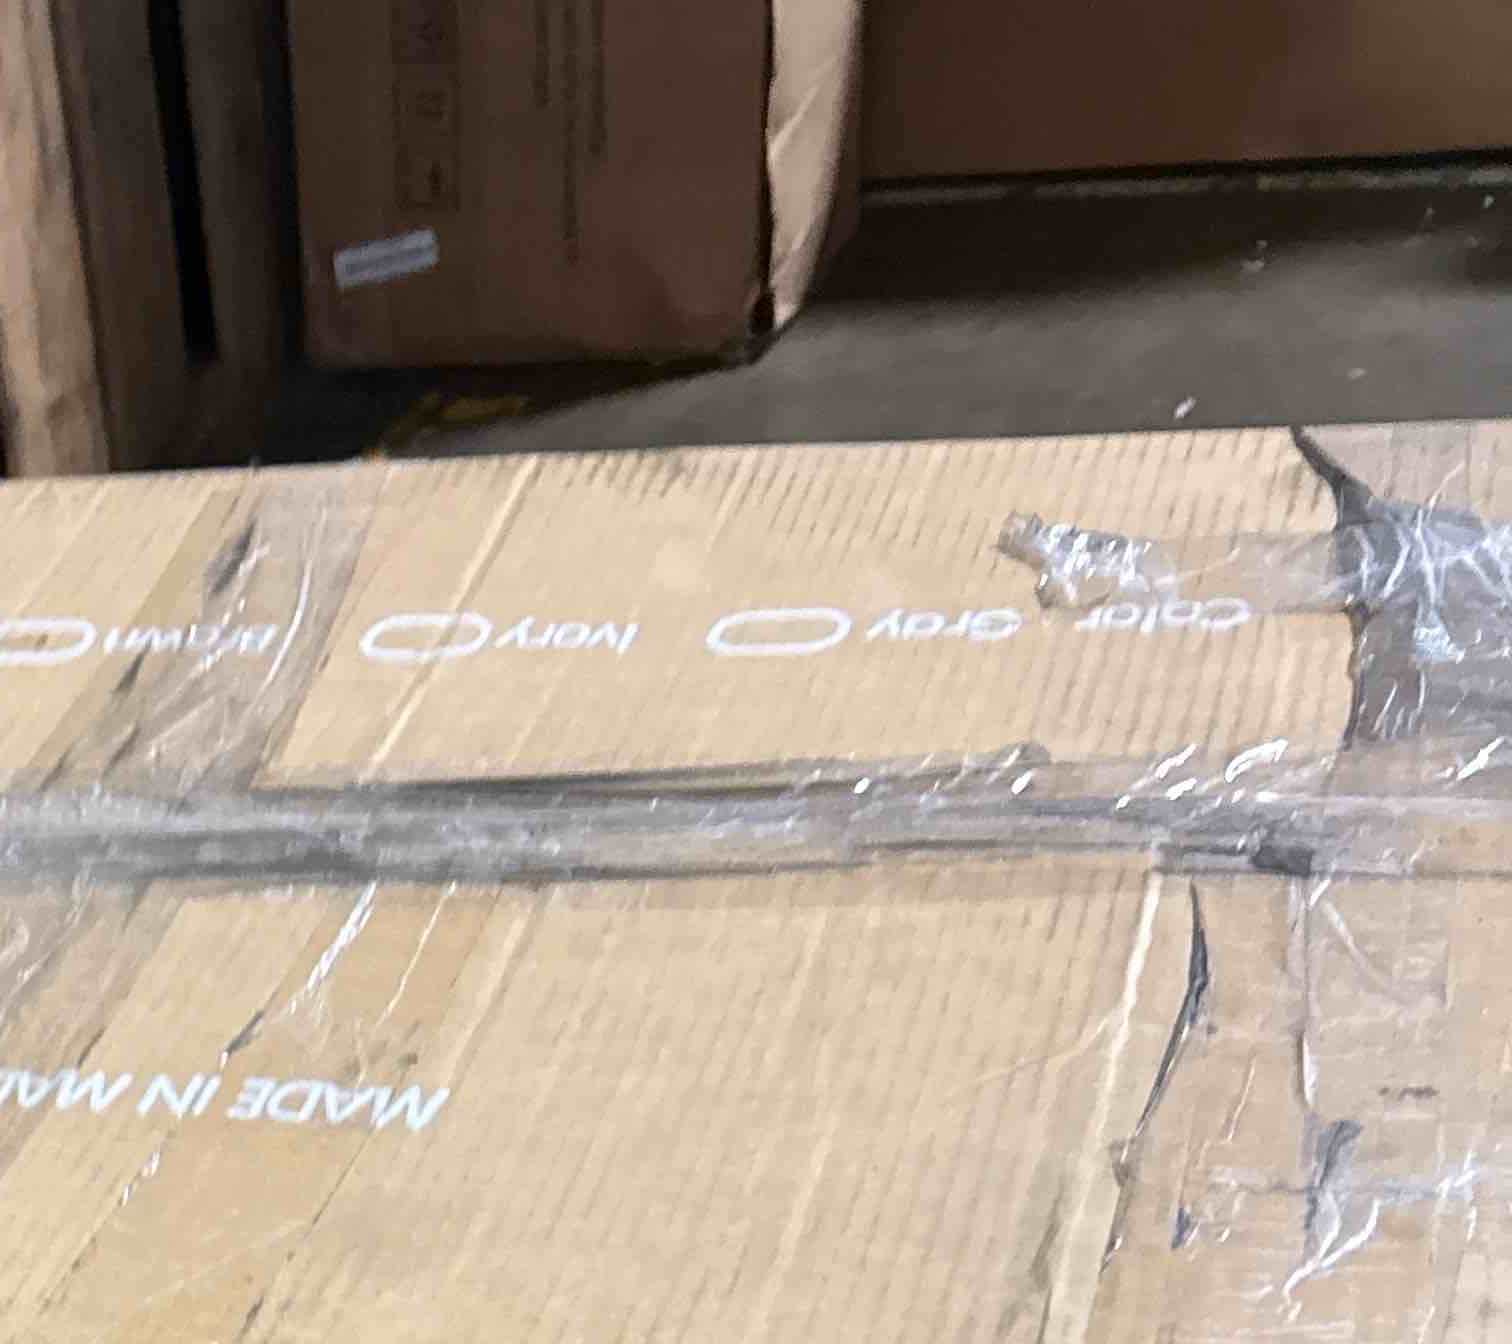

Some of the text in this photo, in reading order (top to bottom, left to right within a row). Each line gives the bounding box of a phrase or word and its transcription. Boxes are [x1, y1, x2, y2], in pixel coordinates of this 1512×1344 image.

[492, 616, 640, 653] Ivory
[864, 606, 1022, 642] Gray
[136, 1073, 220, 1119] IN
[228, 1080, 452, 1132] MADE
